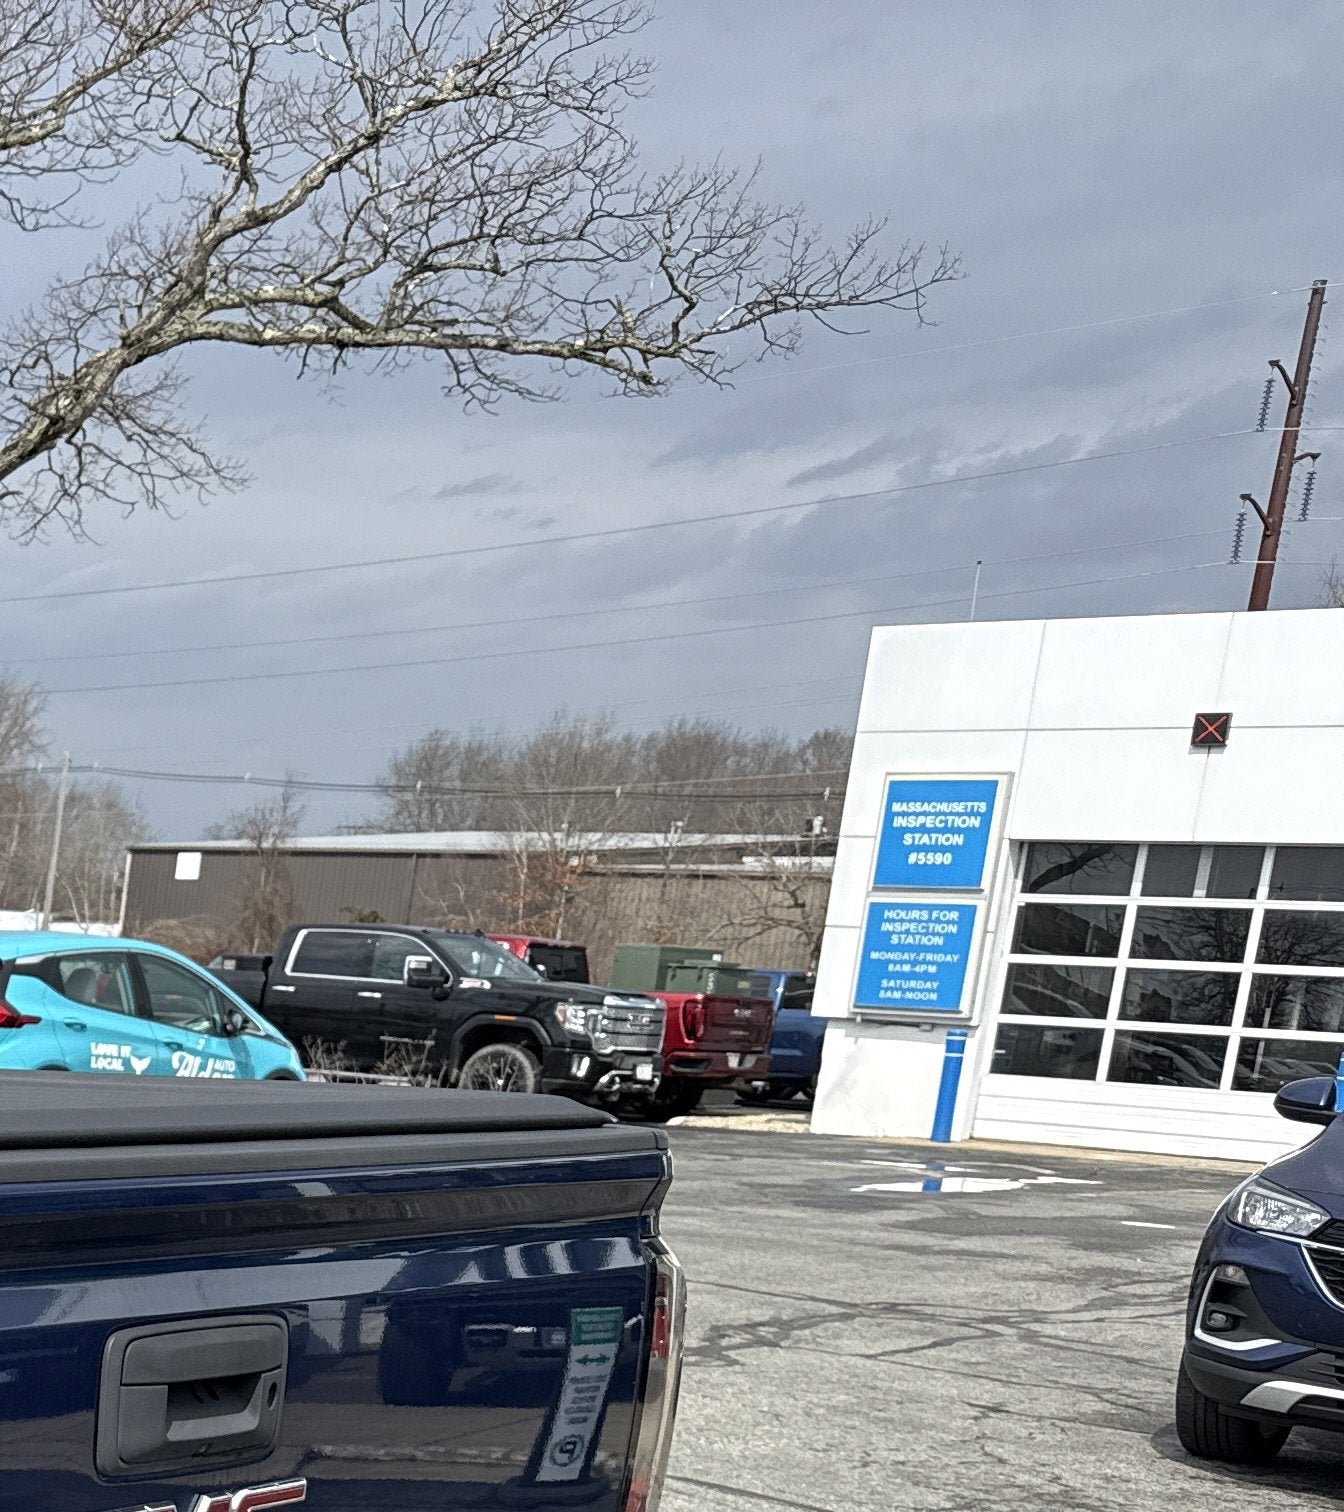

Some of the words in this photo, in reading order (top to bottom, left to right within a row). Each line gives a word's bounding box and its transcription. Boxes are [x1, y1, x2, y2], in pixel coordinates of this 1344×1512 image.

[891, 801, 987, 813] MASSACHUSETTS
[893, 815, 981, 828] INSPECTION
[902, 833, 964, 846] STATION
[908, 852, 952, 865] #5590
[884, 909, 929, 920] HOURS
[932, 910, 959, 922] FOR
[880, 921, 958, 934] INSPECTION
[890, 933, 944, 945] STATION
[870, 950, 960, 962] MONDAY-FRIDAY
[880, 979, 939, 990] SATURDAY
[90, 1042, 119, 1057] LOVE
[120, 1045, 132, 1058] IT
[90, 1055, 125, 1071] LOCAL
[214, 1059, 236, 1071] AUTO
